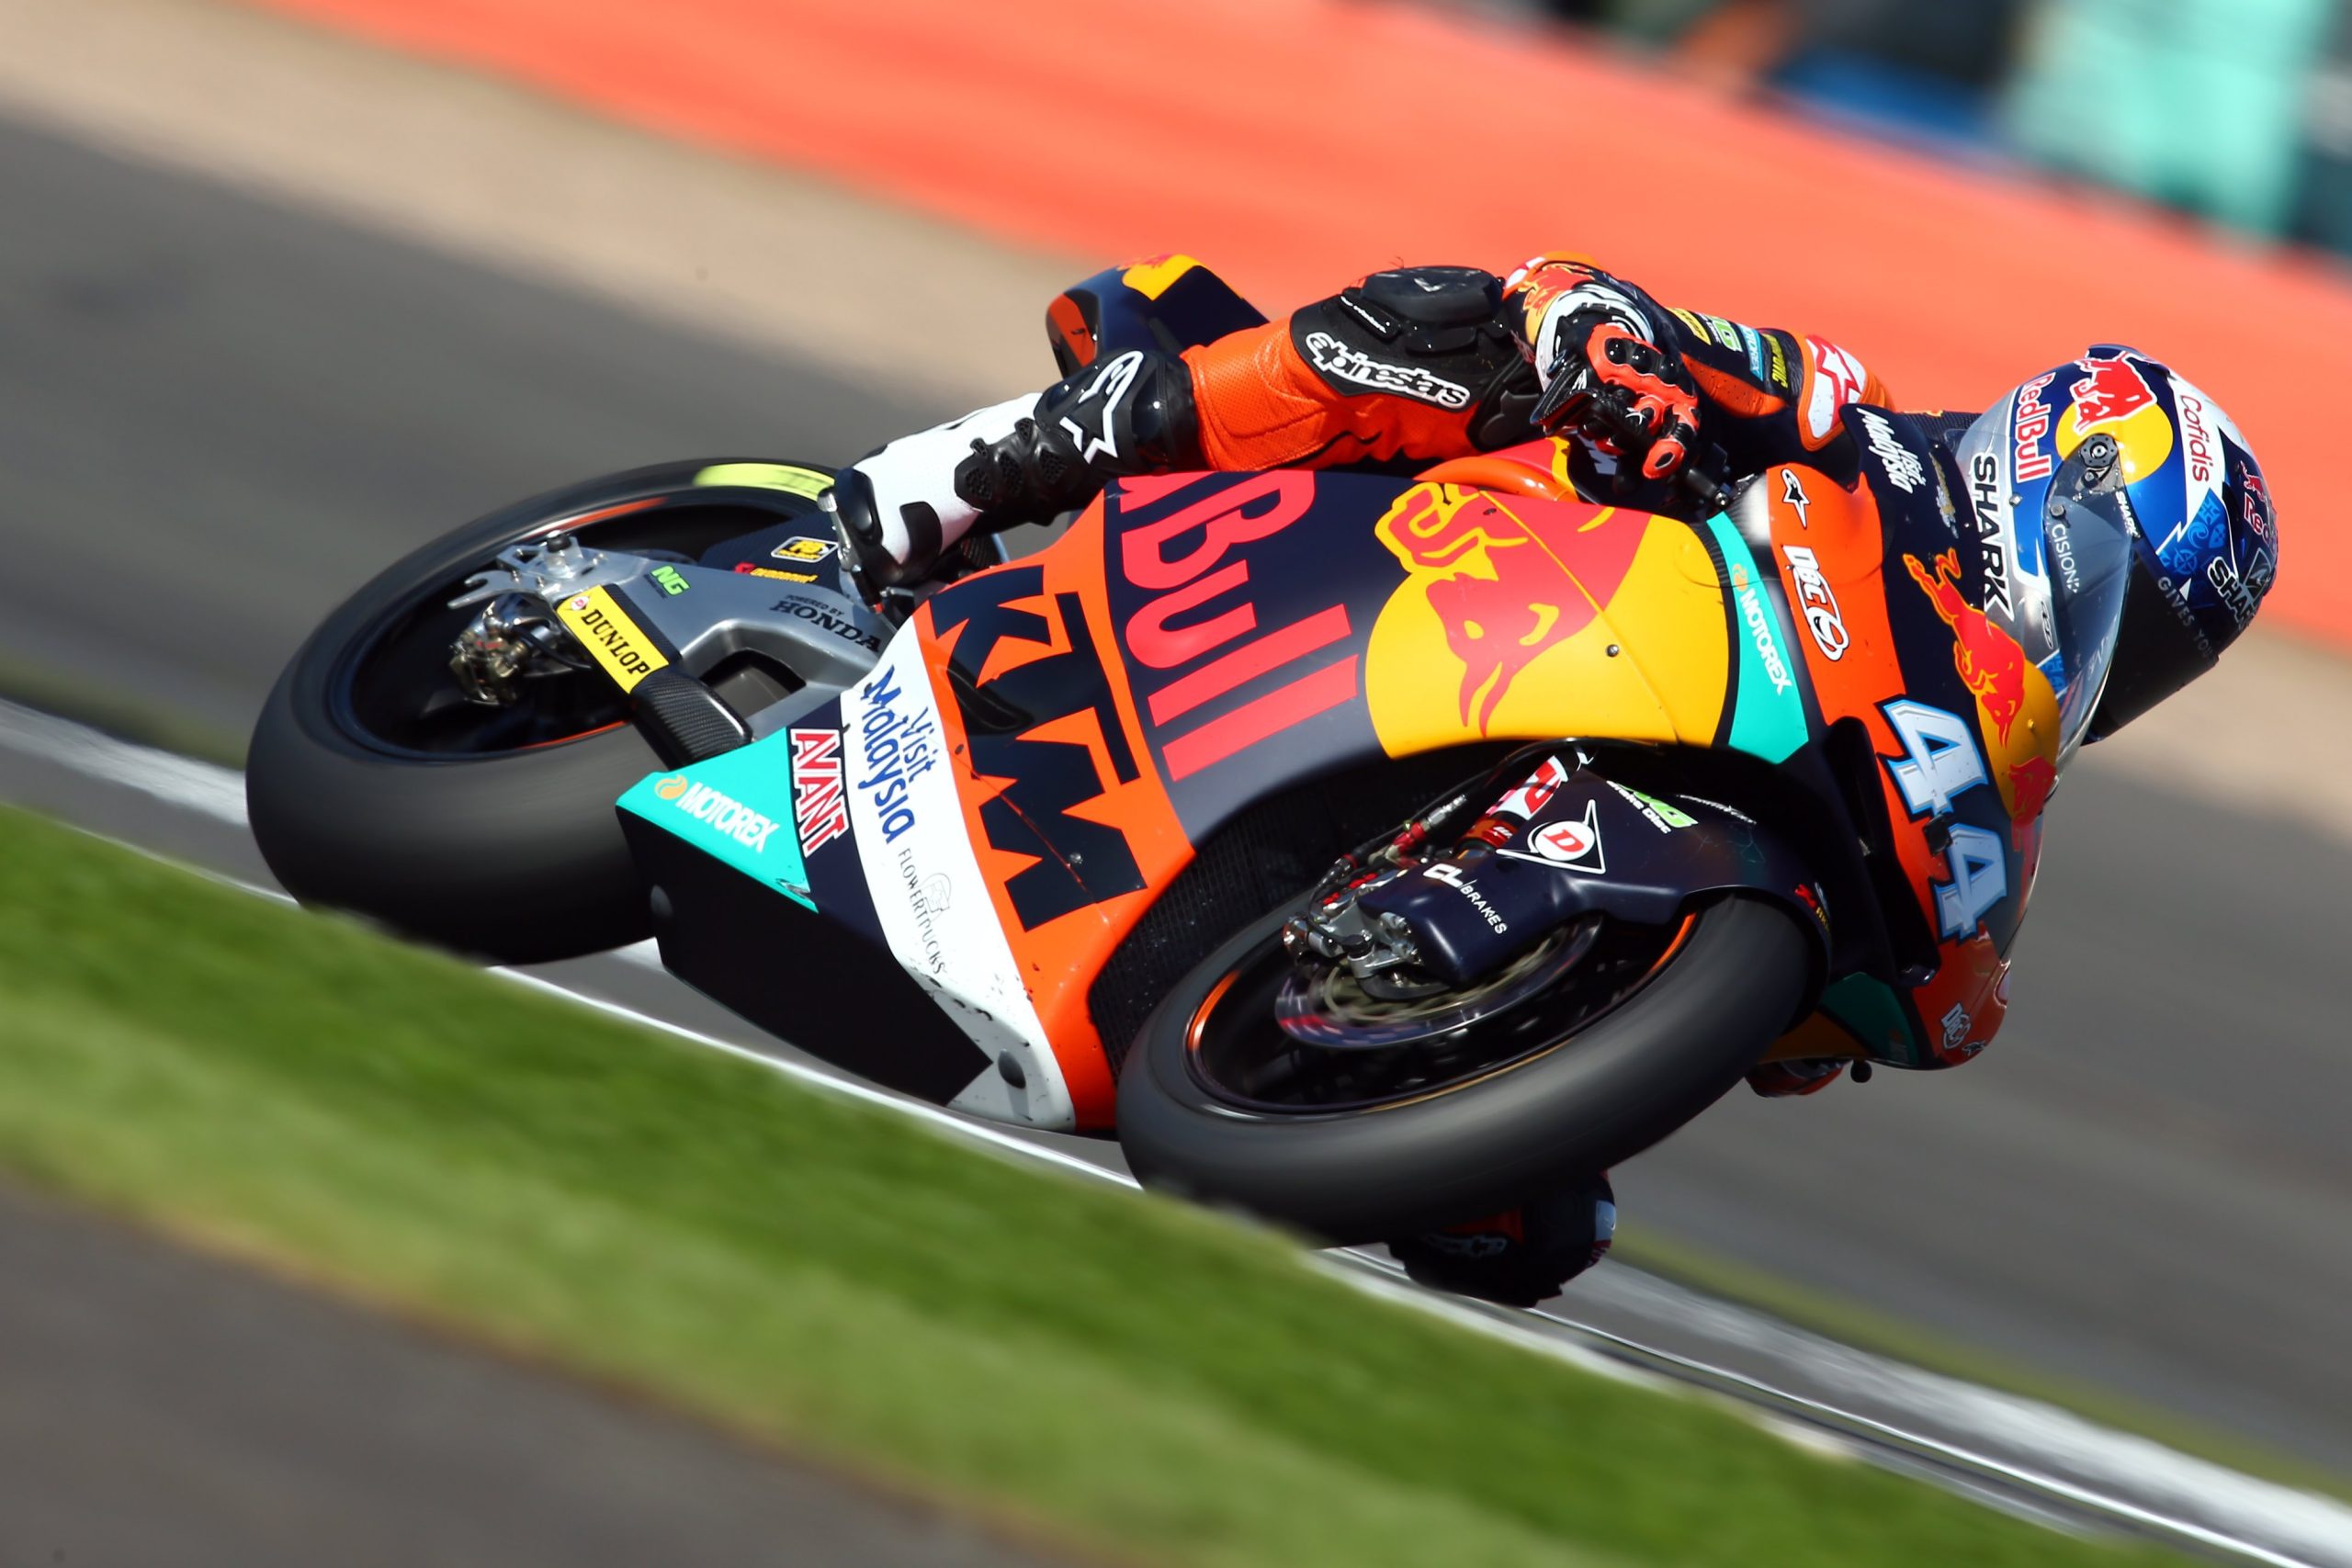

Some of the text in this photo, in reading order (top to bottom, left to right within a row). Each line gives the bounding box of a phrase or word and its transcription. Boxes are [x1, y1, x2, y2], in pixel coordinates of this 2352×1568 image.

[1306, 332, 1470, 408] alpinestars
[2180, 395, 2213, 482] Cofidis
[1973, 452, 2014, 621] SHARK
[2052, 523, 2078, 582] CISION
[650, 565, 691, 596] NG
[786, 594, 844, 616] POWERED BY
[2157, 576, 2196, 626] GIVES
[581, 608, 650, 675] DUNLOP
[770, 600, 881, 653] HONDA
[1739, 588, 1792, 695] MOTOREX
[858, 664, 915, 844] Malaysia
[900, 705, 939, 783] Visit
[928, 564, 1148, 932] KTM
[675, 782, 780, 853] MOTOREX
[1883, 699, 2007, 952] 44
[1460, 885, 1508, 935] BRAKES
